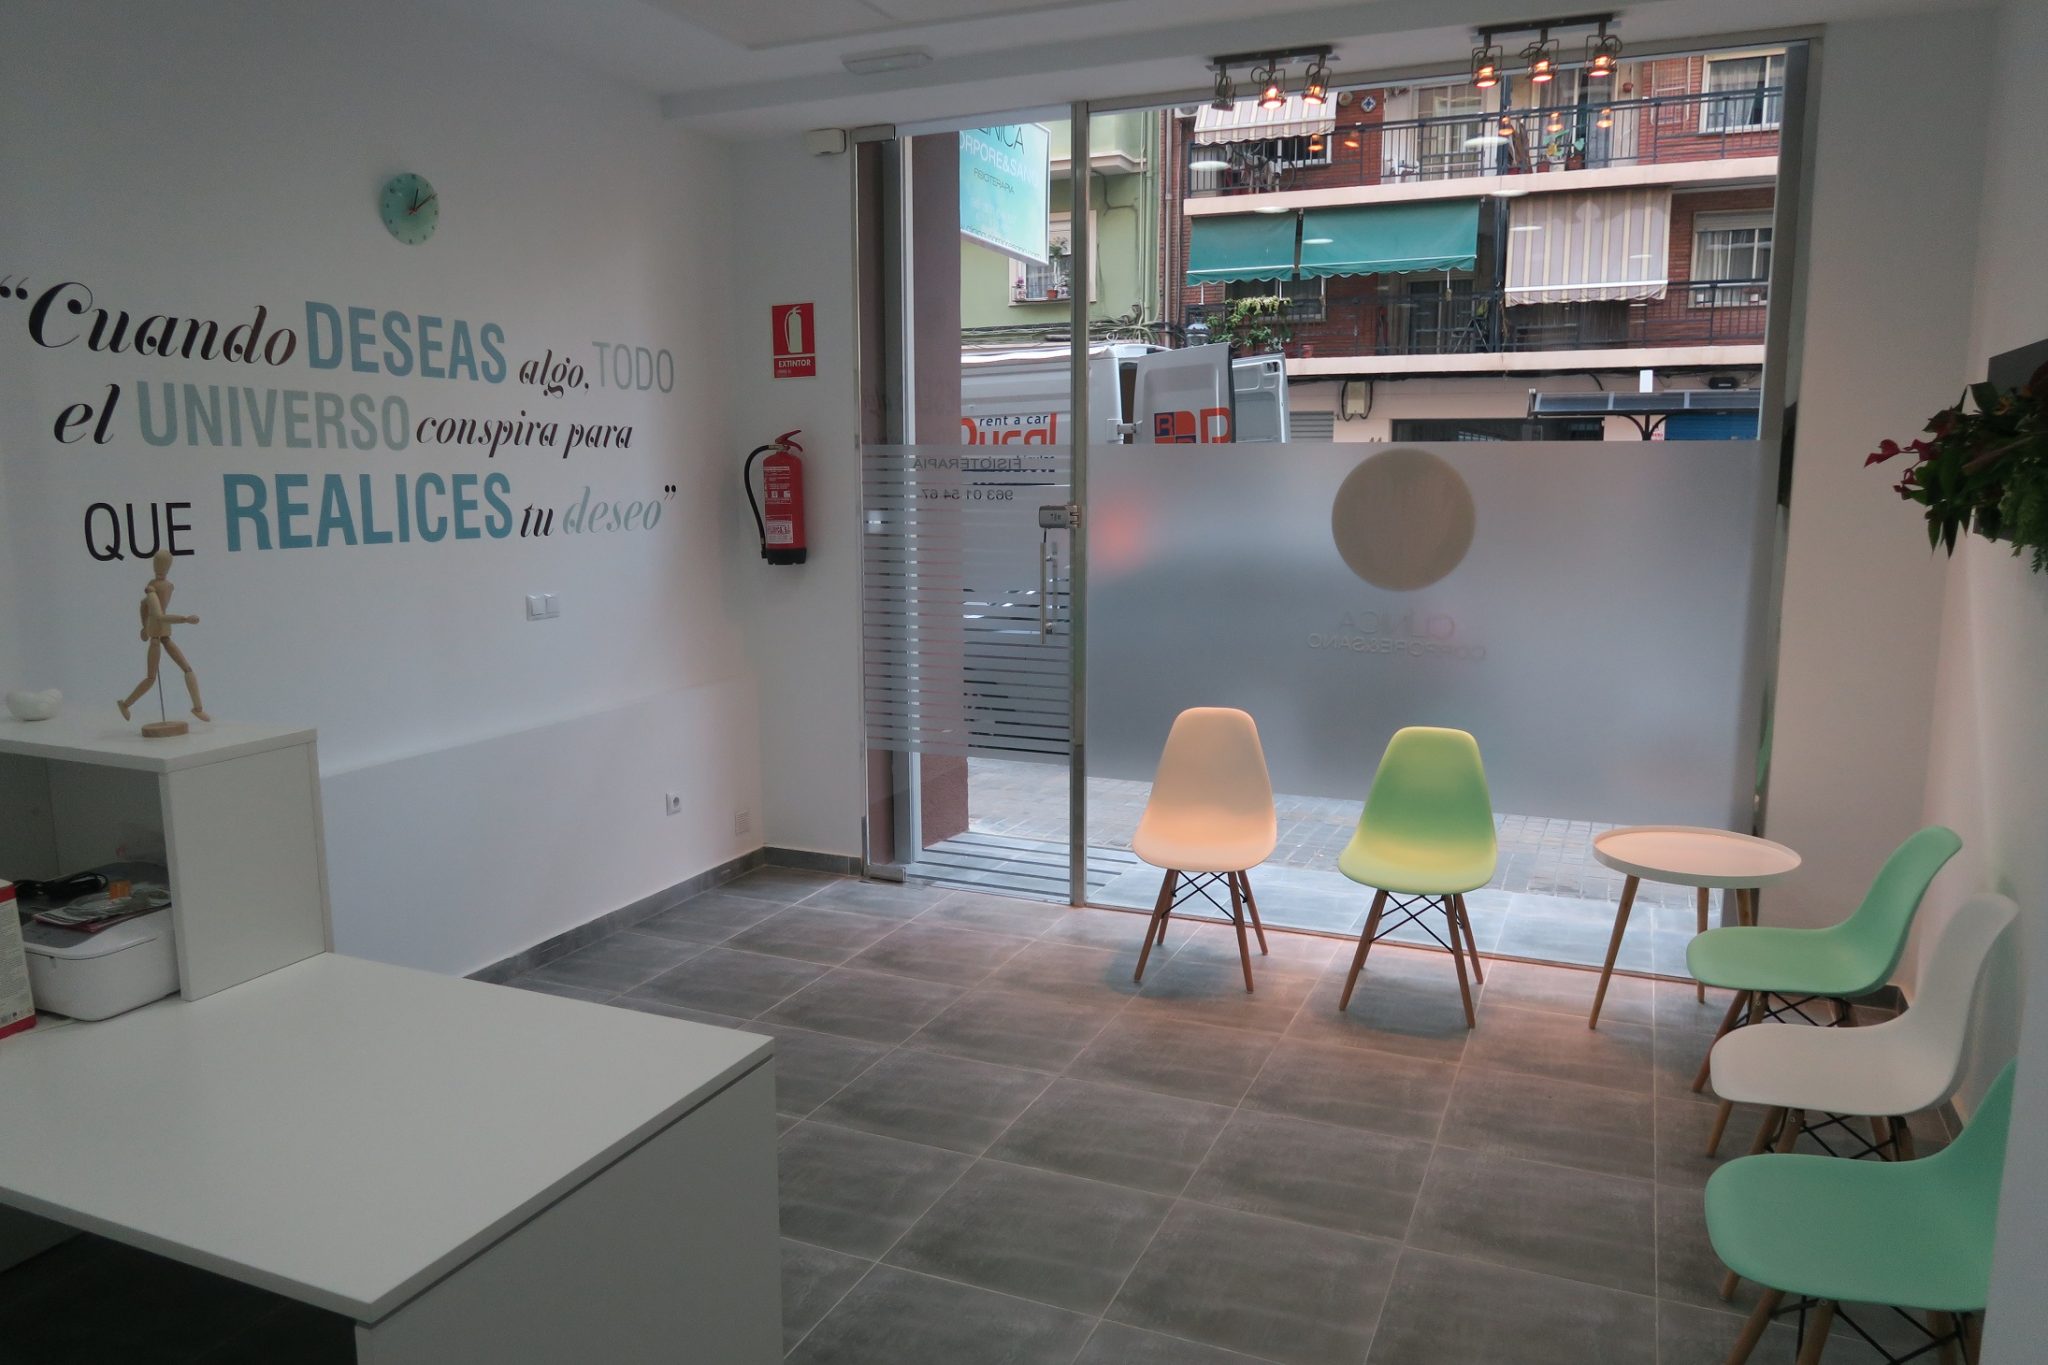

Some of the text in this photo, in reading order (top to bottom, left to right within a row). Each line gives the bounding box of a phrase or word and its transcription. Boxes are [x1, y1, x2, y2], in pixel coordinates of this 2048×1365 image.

[975, 123, 1024, 154] NICA
[305, 301, 507, 383] DESEAS
[519, 349, 590, 399] algo,
[592, 341, 674, 393] TODO
[778, 359, 811, 368] EXTINTOR
[54, 381, 633, 458] el UNIVERSO conspira para
[980, 414, 1048, 427] rent a car
[84, 502, 195, 561] QUE
[223, 472, 512, 552] REALICES
[519, 501, 554, 538] tu
